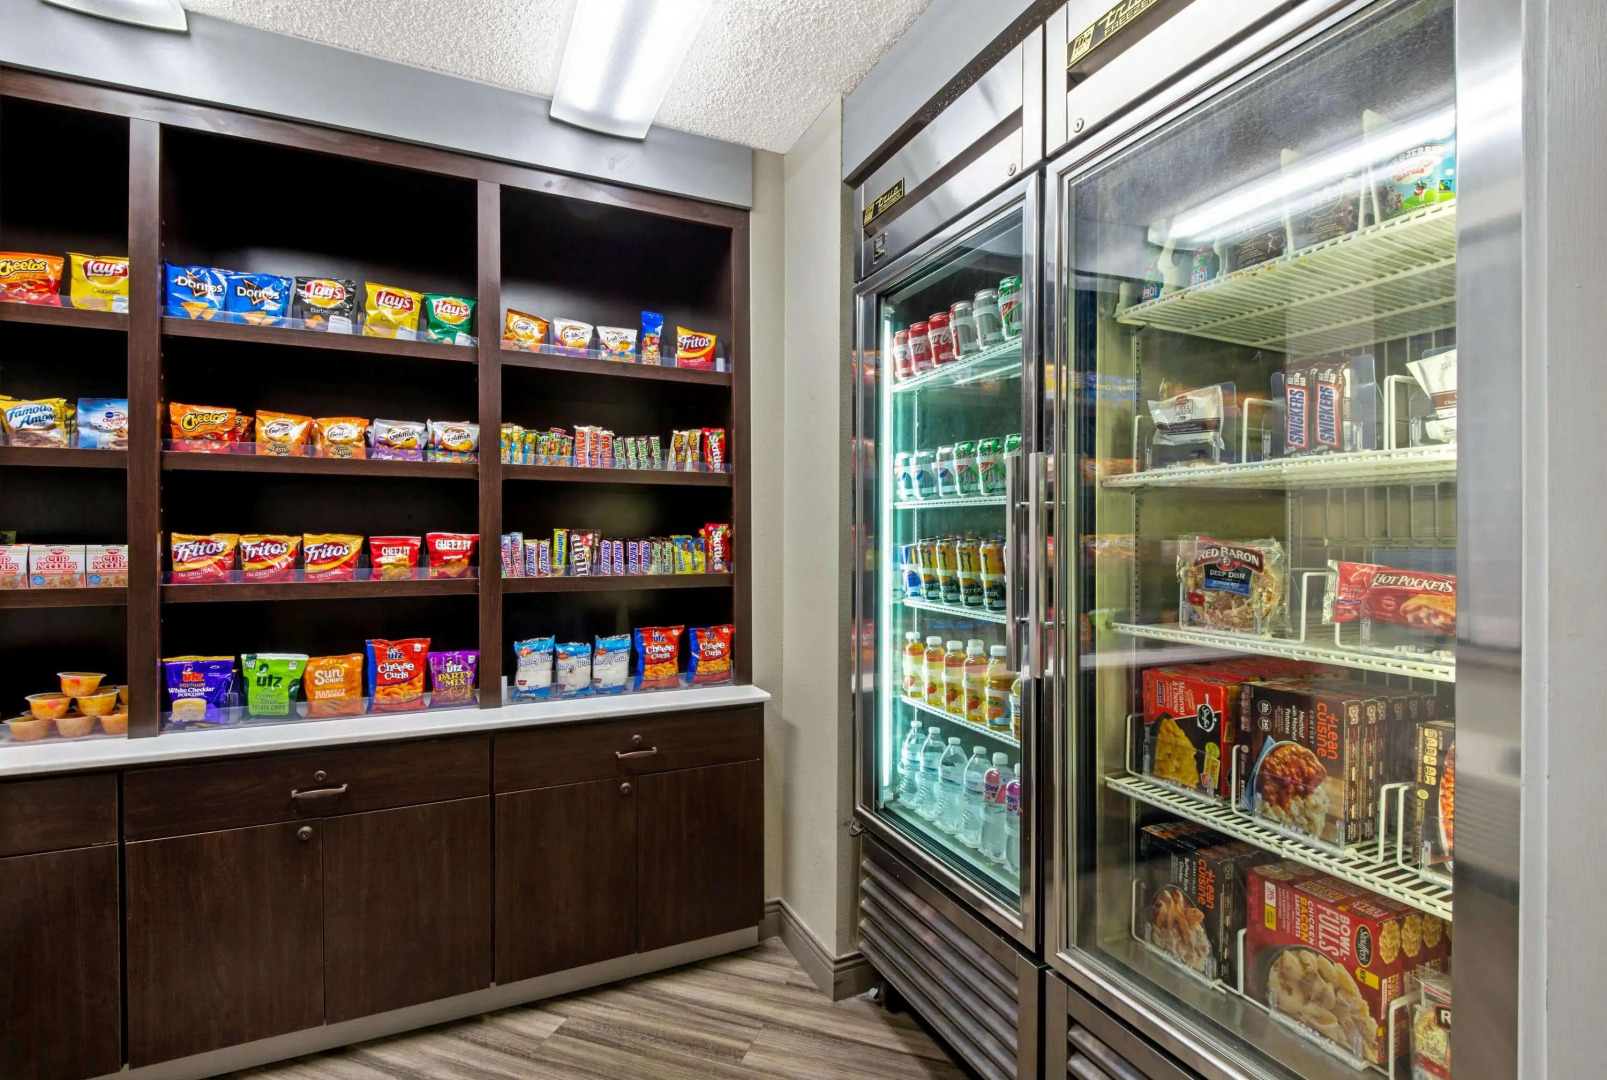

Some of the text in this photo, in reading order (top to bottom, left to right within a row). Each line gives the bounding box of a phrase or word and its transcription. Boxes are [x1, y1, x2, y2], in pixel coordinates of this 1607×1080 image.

[0, 259, 47, 276] Cheetos
[177, 275, 223, 293] Doritos
[236, 286, 280, 300] Doritos
[310, 307, 340, 315] Barbecue
[678, 335, 710, 350] Fritos
[6, 404, 53, 423] Famous
[181, 412, 228, 431] Cheetos
[1289, 389, 1305, 445] SNICKERS
[1318, 385, 1336, 443] SNICKERS
[172, 541, 225, 562] Fritos
[240, 541, 288, 562] Fritos
[304, 543, 350, 563] Fritos
[602, 541, 611, 573] SNICKERS
[614, 541, 623, 573] SNICKERS
[629, 541, 638, 573] SNICKERS
[642, 541, 650, 572] SNICKERS
[1198, 547, 1259, 567] RED BARON
[36, 562, 77, 570] NOODLES
[1228, 571, 1246, 579] DISH
[1371, 573, 1455, 593] HOT POCKETS
[645, 645, 675, 654] Cheese
[651, 652, 670, 660] Curls
[700, 642, 725, 651] Cheese
[705, 649, 722, 657] Curls
[314, 669, 345, 686] Sun
[377, 662, 415, 673] Cheese
[383, 671, 409, 680] Curls
[438, 671, 471, 681] PARTY
[445, 678, 466, 686] MIX
[1172, 687, 1180, 713] Cheese
[1178, 681, 1186, 715] Macaroni
[1327, 722, 1338, 760] Lean
[1206, 877, 1215, 909] Lean
[1300, 896, 1308, 943] BACON
[1317, 904, 1339, 957] FULLS
[1339, 913, 1351, 961] BOWL-
[1358, 929, 1370, 962] Stouffer's
